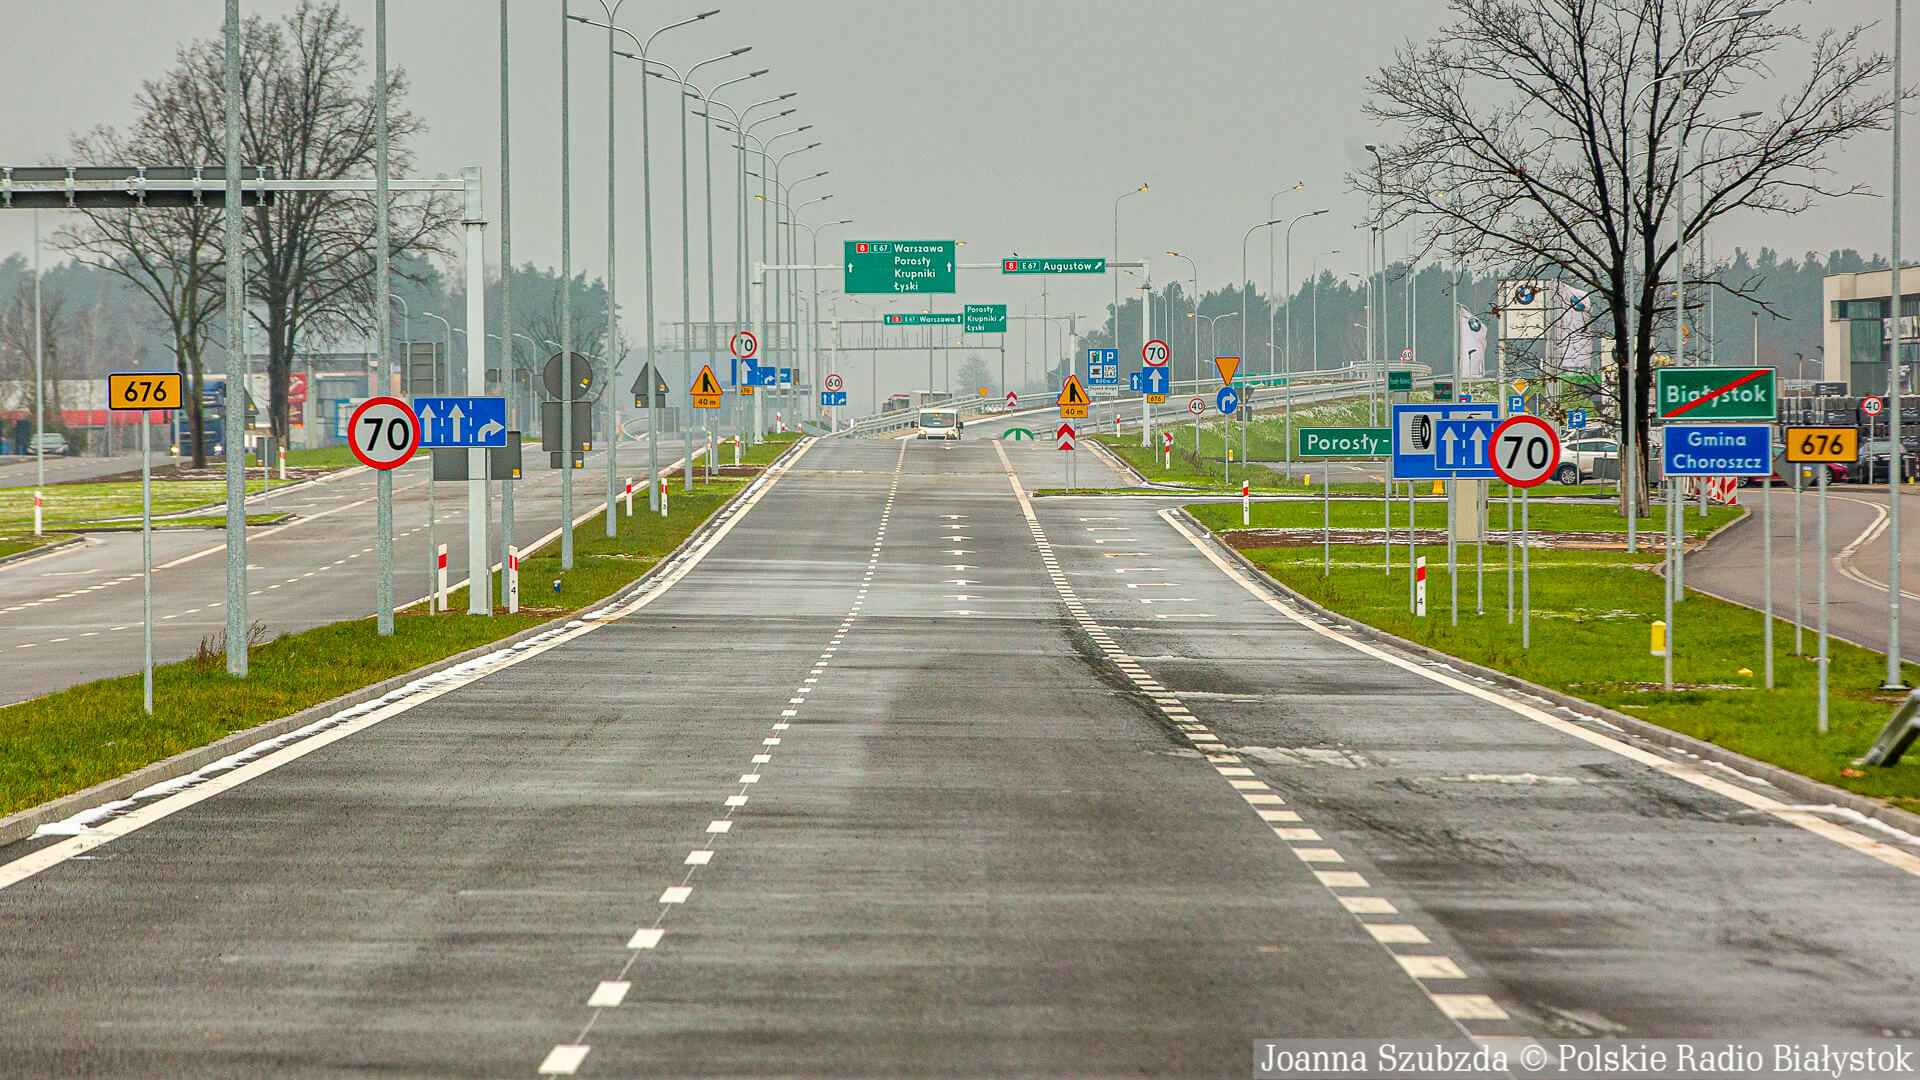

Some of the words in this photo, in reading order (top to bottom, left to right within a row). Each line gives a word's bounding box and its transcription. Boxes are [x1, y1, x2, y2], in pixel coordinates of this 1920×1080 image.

[894, 244, 944, 253] Warszawa
[1043, 262, 1092, 273] Augustów
[894, 269, 936, 280] Krupniki
[893, 281, 919, 293] Łyski
[967, 314, 997, 324] Krupniki
[1106, 351, 1114, 362] P
[1148, 347, 1166, 360] 70
[1402, 351, 1412, 359] 60
[828, 378, 841, 388] 60
[124, 380, 167, 402] 676
[1666, 384, 1767, 408] Białystok
[1191, 402, 1203, 410] 40
[1512, 397, 1522, 411] P
[1865, 401, 1880, 411] 40
[1065, 407, 1076, 415] 40
[363, 417, 410, 451] 70
[1687, 431, 1747, 446] Gmina
[1308, 434, 1379, 454] Porosły
[1801, 434, 1843, 455] 676
[1504, 436, 1549, 469] 70
[1673, 453, 1763, 469] Choroszcz
